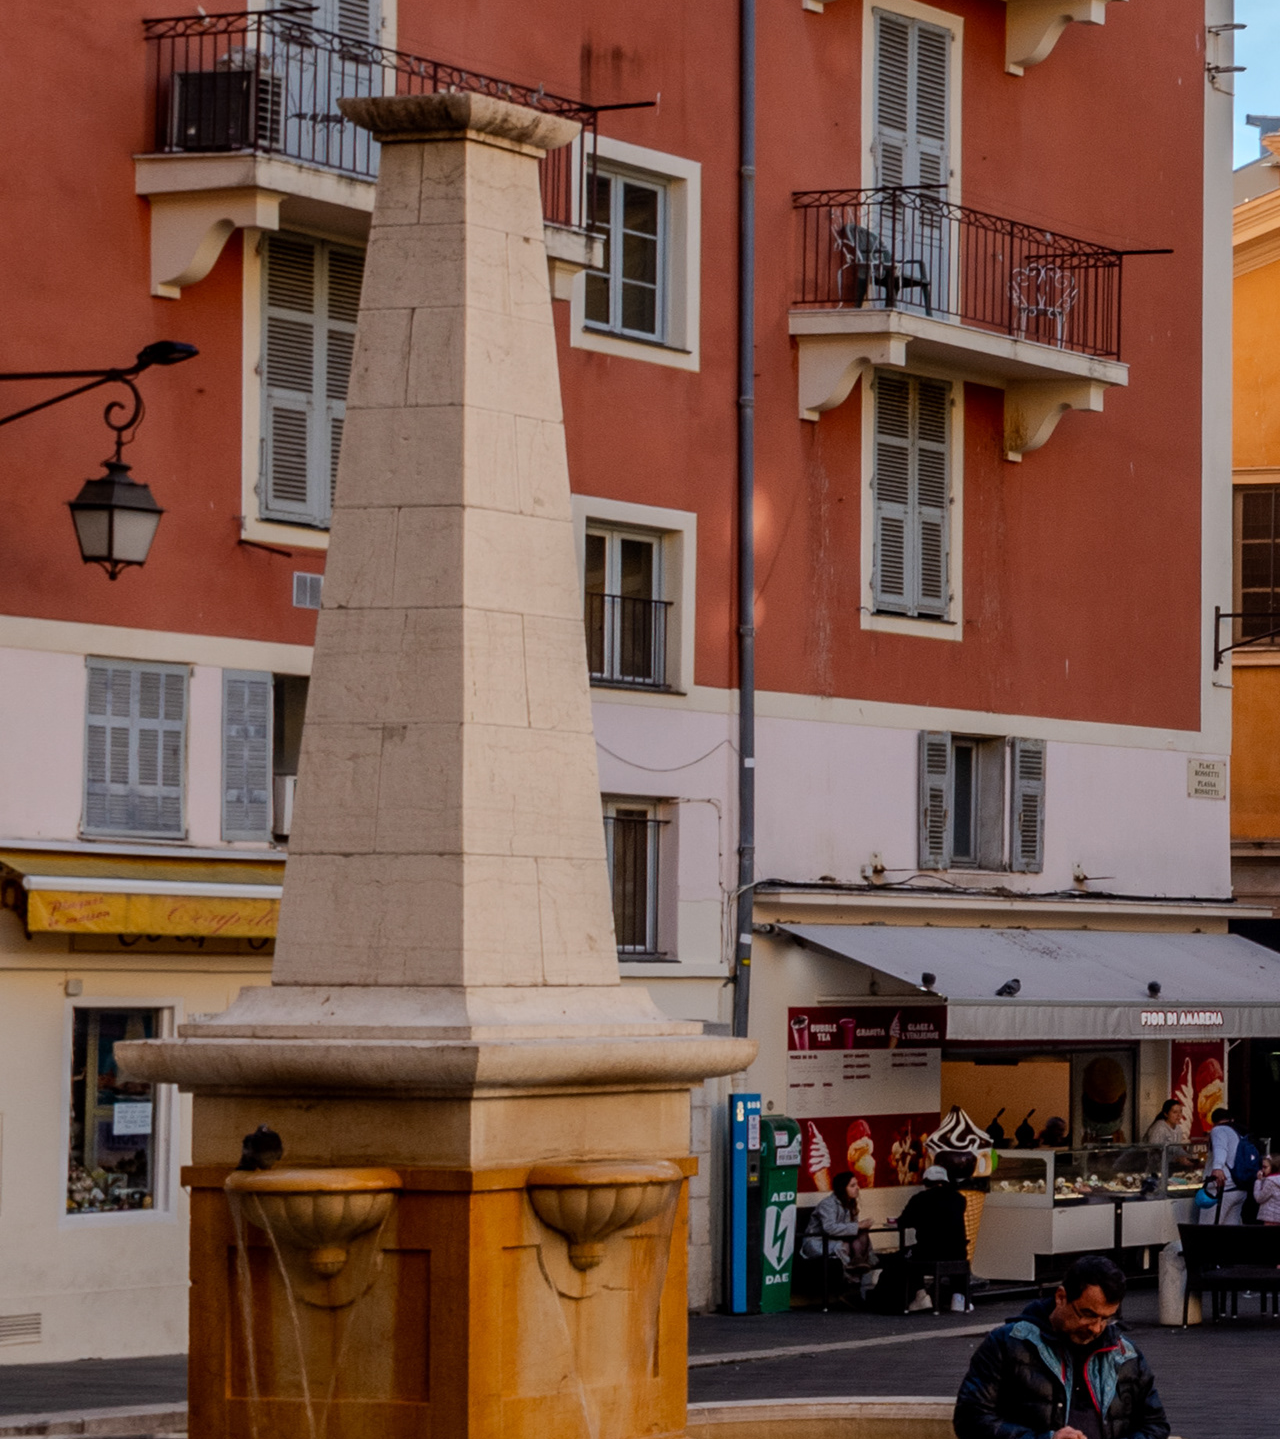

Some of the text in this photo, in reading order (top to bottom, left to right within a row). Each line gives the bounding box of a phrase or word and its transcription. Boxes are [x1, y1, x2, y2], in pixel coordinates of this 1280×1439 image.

[1141, 1011, 1224, 1026] FIOR DI AMARENA
[817, 1033, 831, 1042] TEA
[771, 1191, 795, 1203] AED
[765, 1272, 790, 1285] DAE
